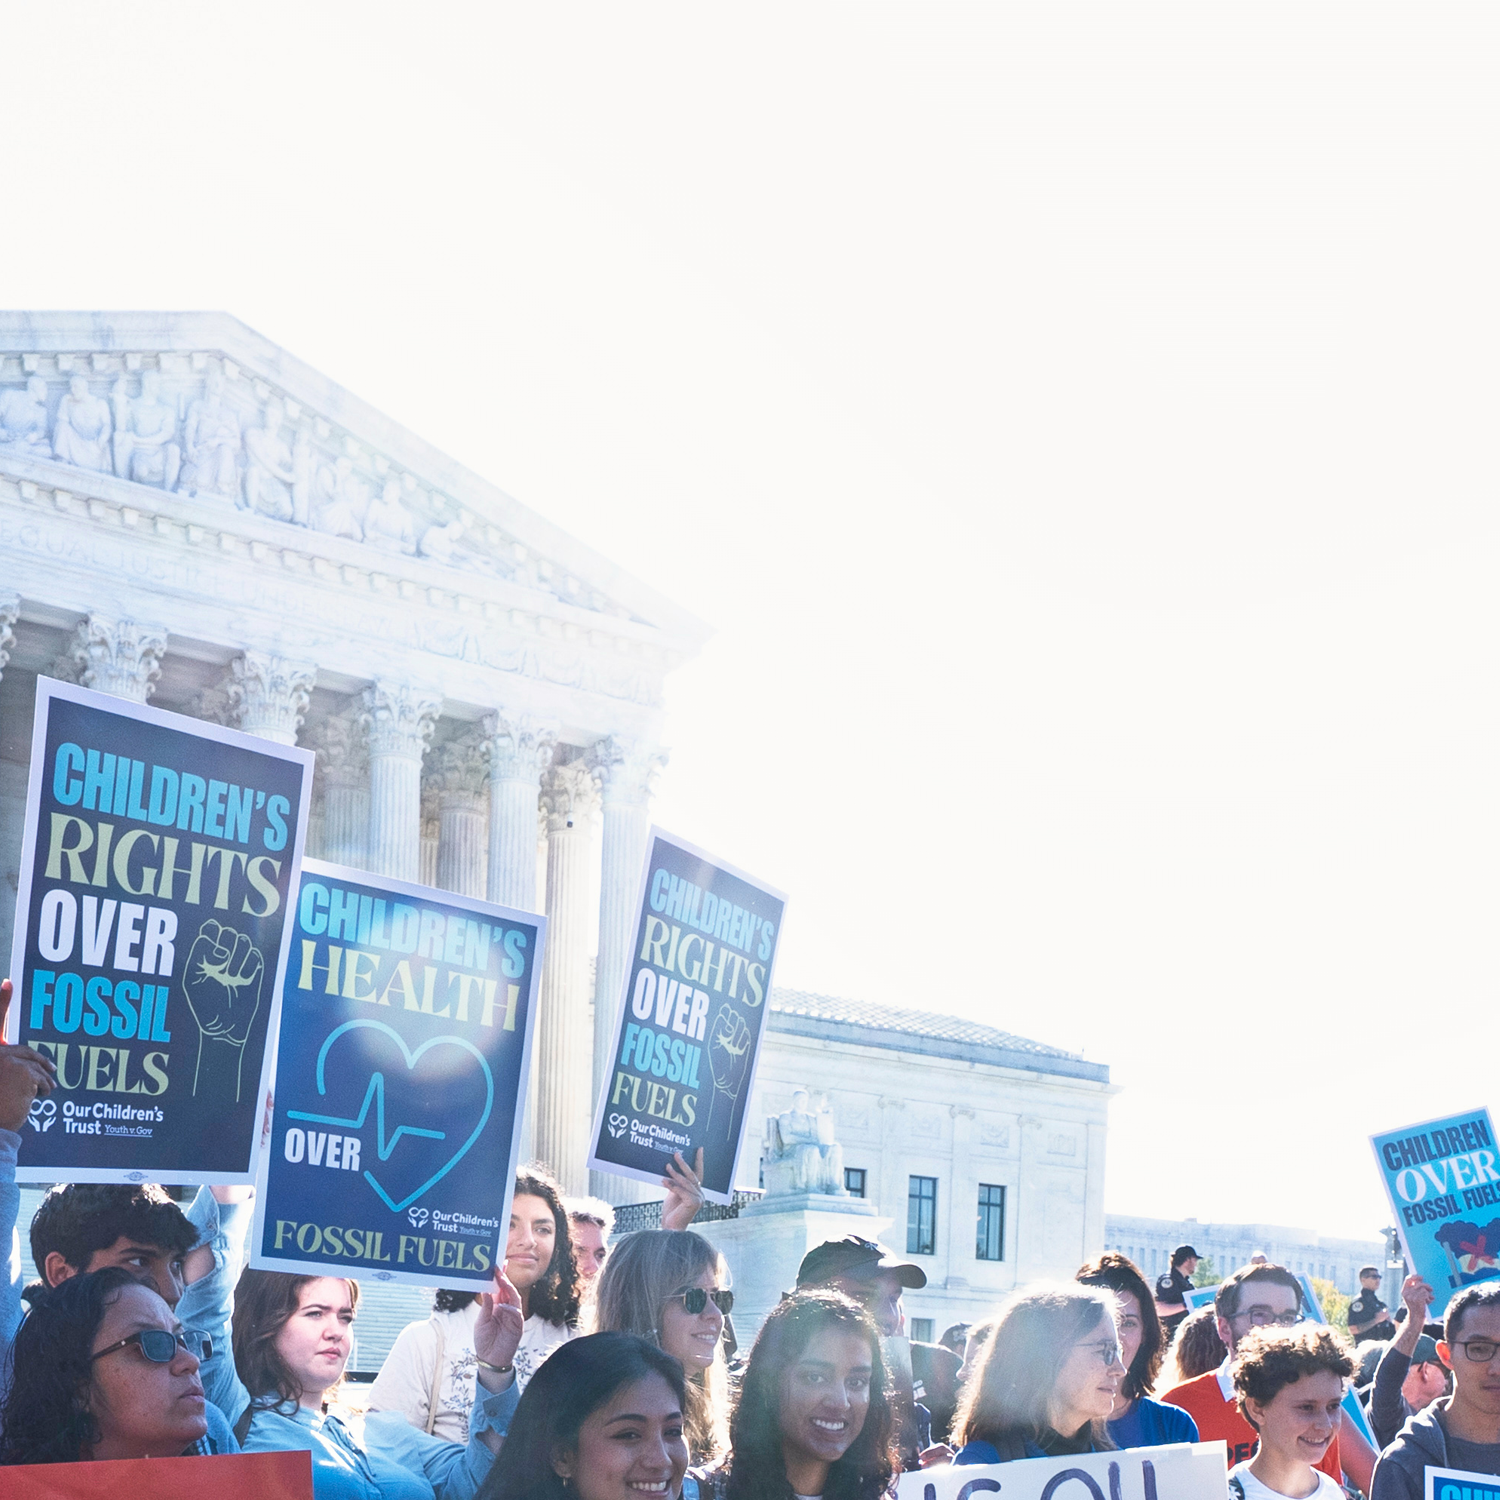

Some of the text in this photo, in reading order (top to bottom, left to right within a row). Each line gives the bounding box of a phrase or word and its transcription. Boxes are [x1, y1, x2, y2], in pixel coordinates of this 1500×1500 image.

[53, 742, 290, 852] CHILDREN'S
[44, 811, 282, 918] RIGHTS
[38, 889, 178, 977] OVER
[300, 882, 526, 979] CHILDREN'S
[649, 868, 775, 961] CHILDREN'S
[298, 939, 520, 1031] HEALTH
[640, 914, 767, 1008] RIGHTS
[29, 969, 171, 1044] FOSSIL
[632, 967, 710, 1042] OVER
[620, 1022, 702, 1091] FOSSIL
[62, 1100, 92, 1118] Our
[63, 1117, 101, 1135] Trust
[104, 1124, 129, 1134] Youth
[136, 1126, 153, 1136] Gov
[611, 1071, 698, 1128] FUELS
[631, 1119, 649, 1134] Our
[284, 1127, 361, 1172] OVER
[630, 1131, 653, 1148] Trust
[1382, 1119, 1492, 1171] CHILDREN
[1396, 1150, 1500, 1203] OVER
[432, 1209, 452, 1222] Our
[432, 1220, 458, 1233] Trust
[1402, 1194, 1462, 1228] FOSSIL
[273, 1219, 491, 1273] FOSSIL FUELS
